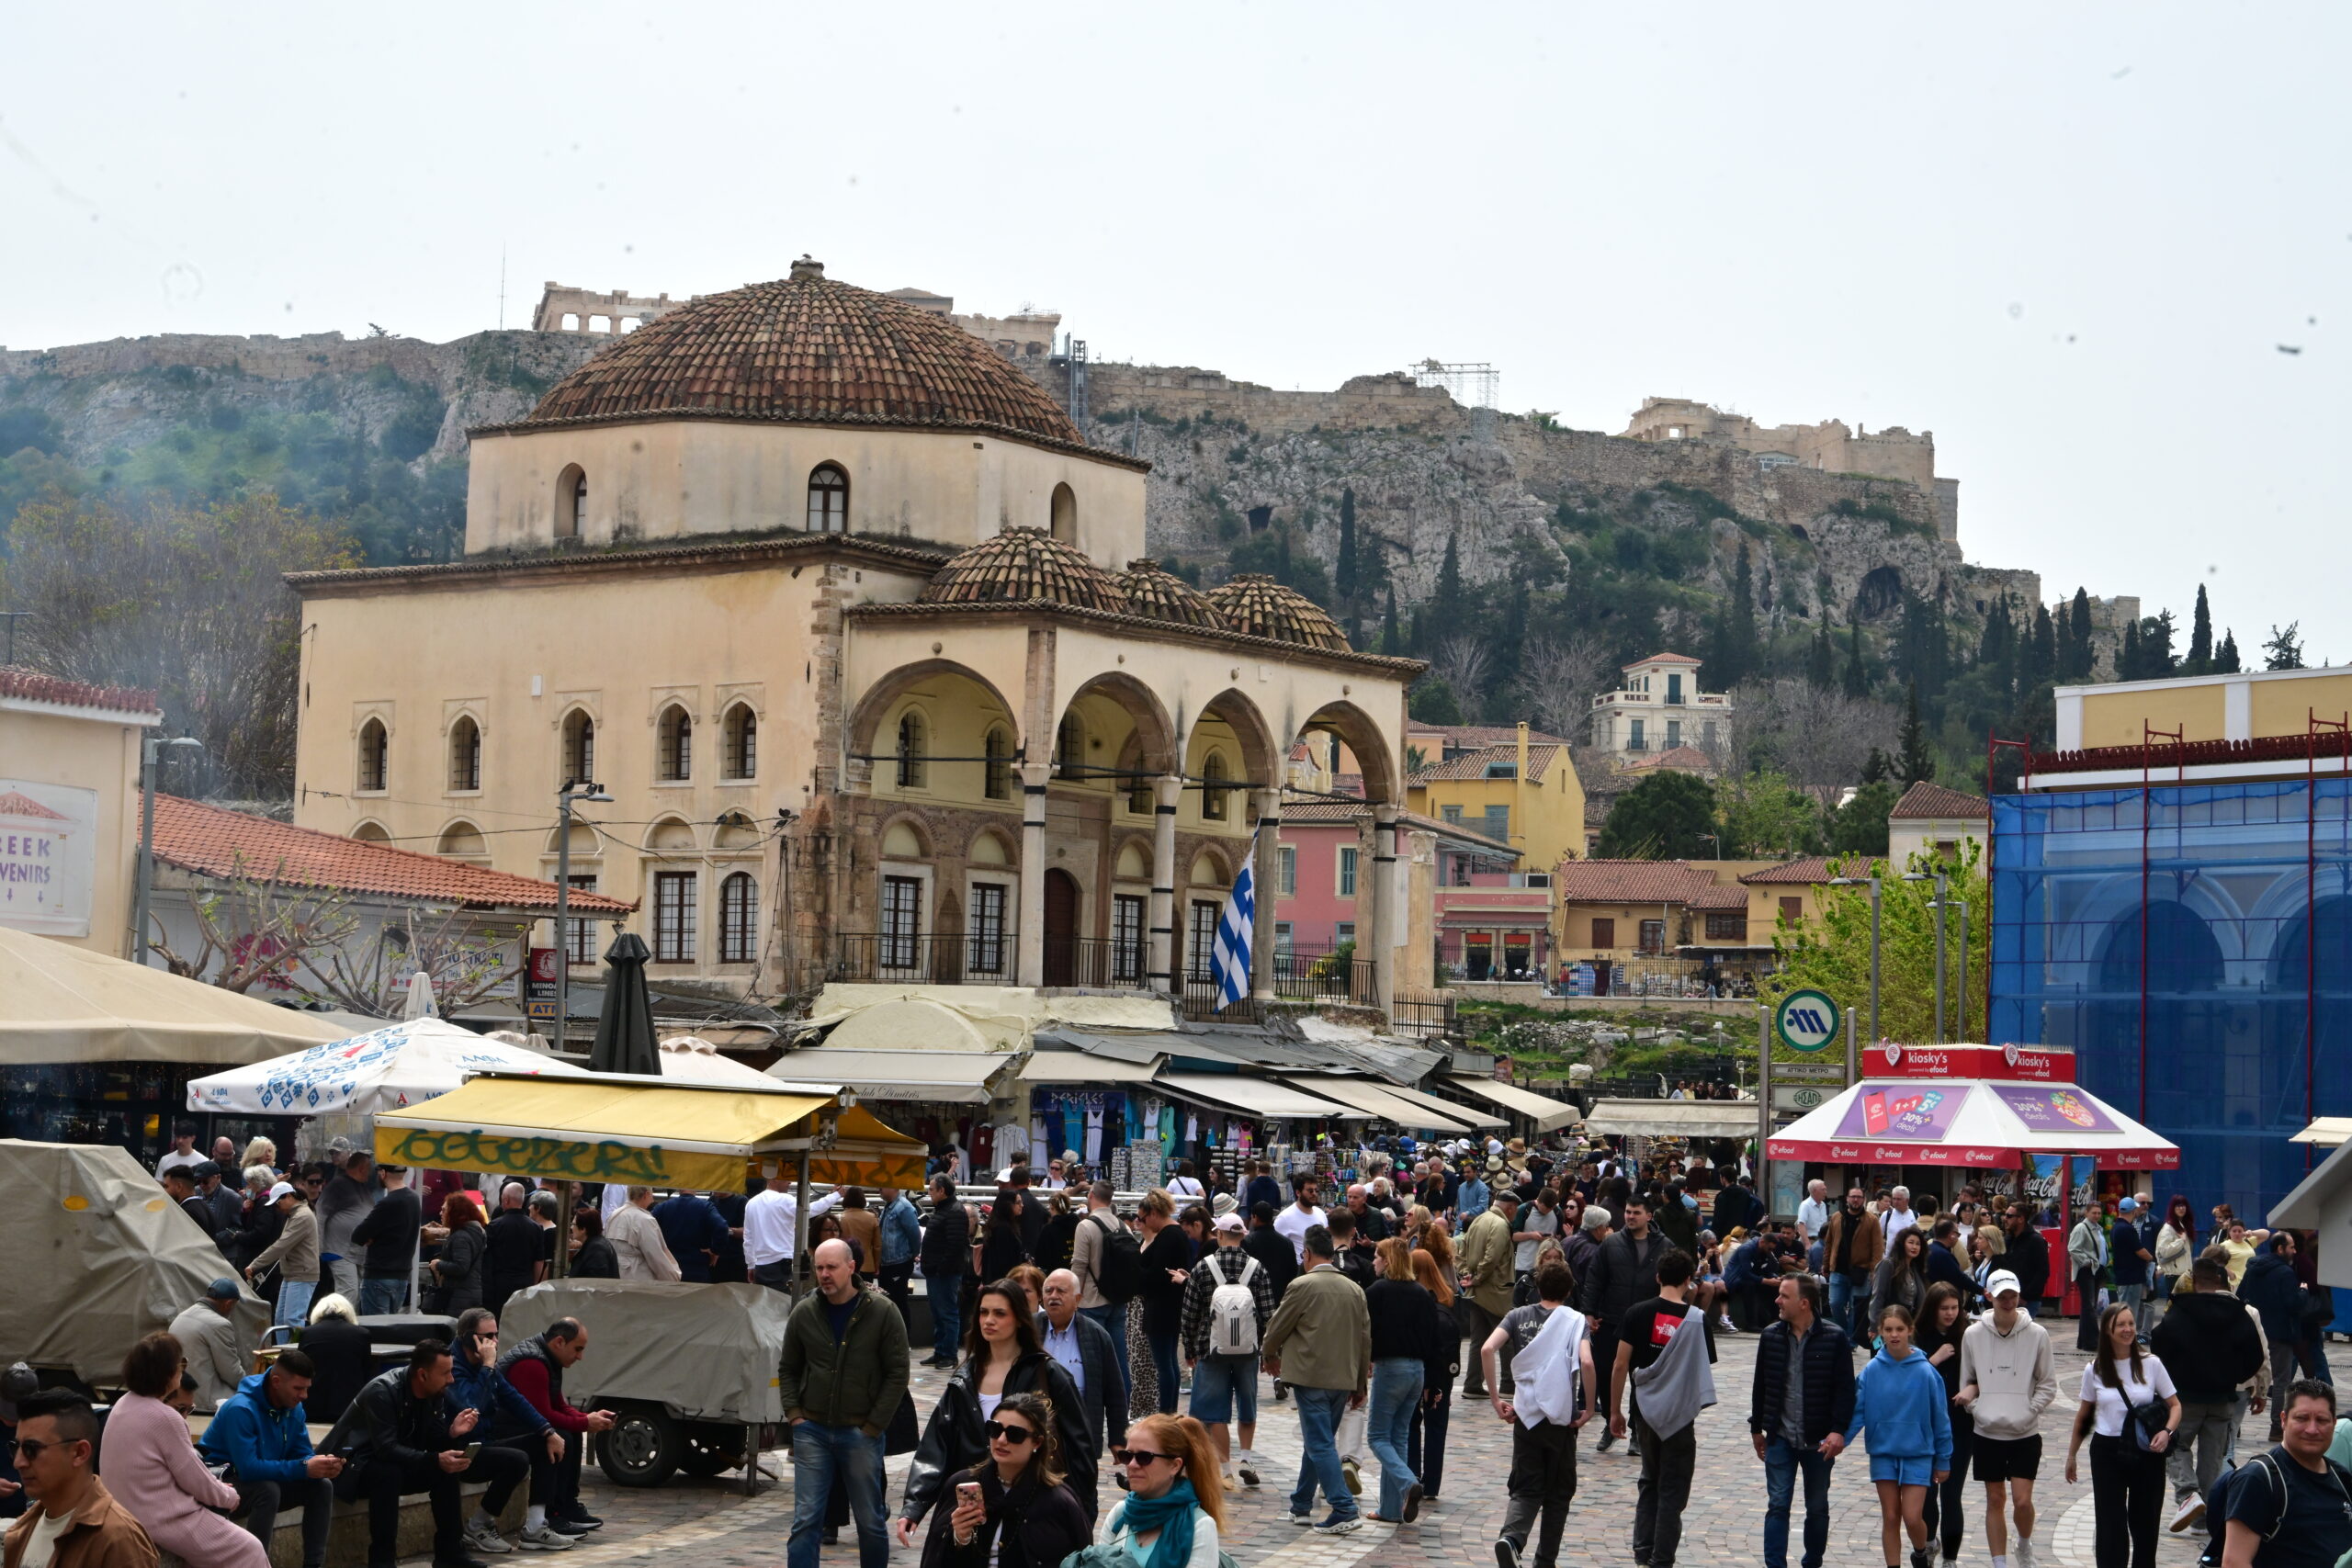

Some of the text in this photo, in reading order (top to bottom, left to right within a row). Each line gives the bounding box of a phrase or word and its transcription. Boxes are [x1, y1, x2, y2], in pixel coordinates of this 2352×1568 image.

[0, 835, 51, 857] EEK
[1908, 1052, 1948, 1065] kiosky's
[2018, 1055, 2050, 1068] kiosky's
[2035, 1069, 2050, 1077] efood
[1778, 1145, 1795, 1155] efood
[1840, 1148, 1858, 1157] efood
[1884, 1150, 1903, 1158] efood
[1929, 1151, 1948, 1159] efood
[1975, 1153, 1995, 1161] efood
